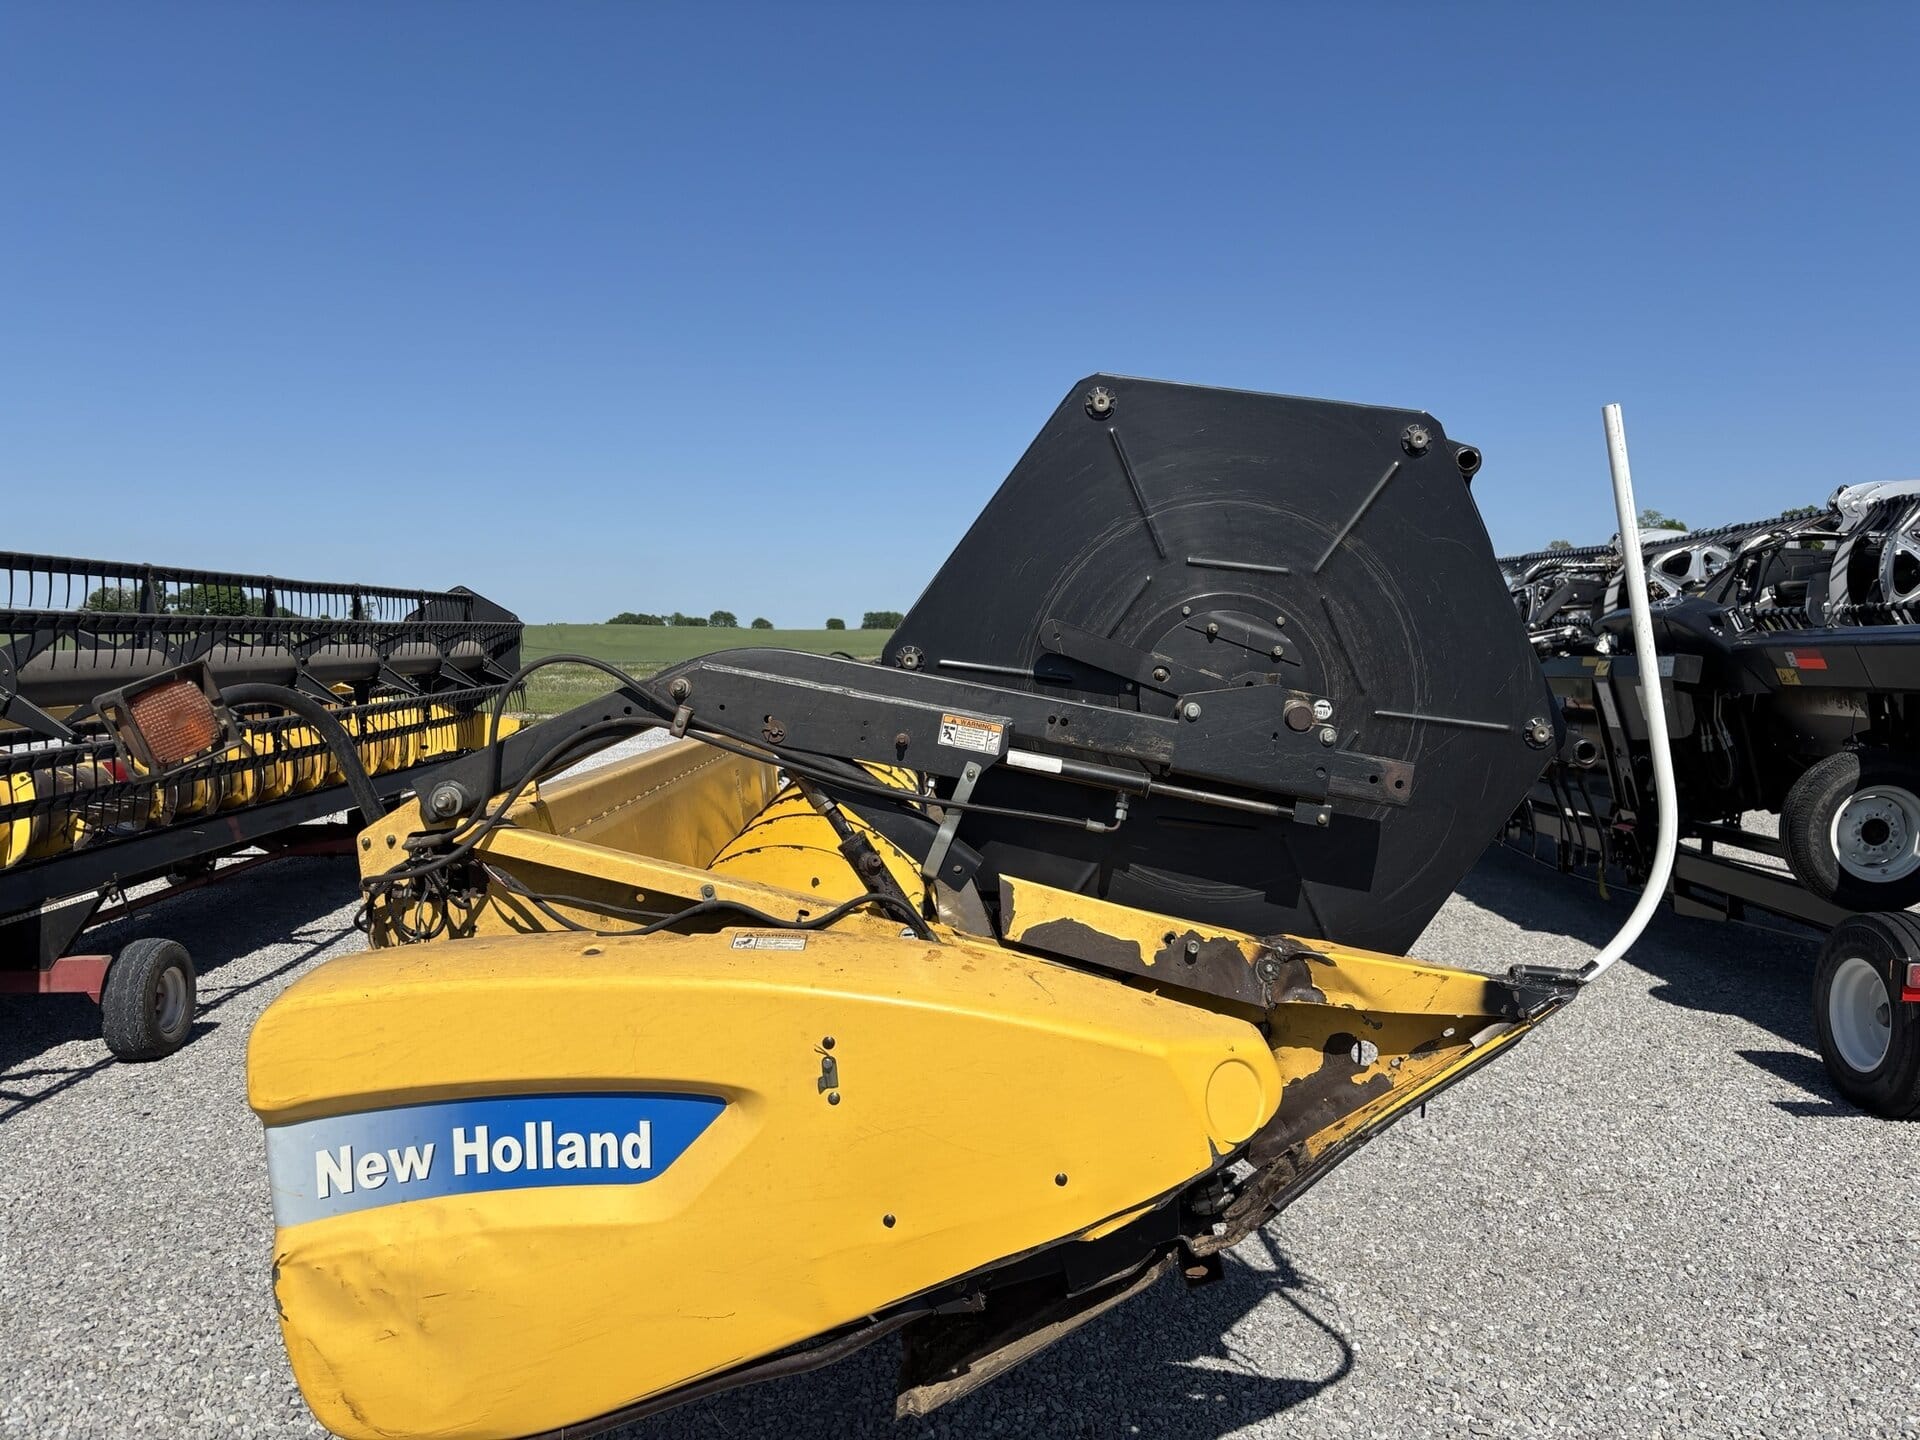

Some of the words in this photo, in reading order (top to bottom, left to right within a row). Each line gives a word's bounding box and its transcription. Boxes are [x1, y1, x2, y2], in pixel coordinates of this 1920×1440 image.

[961, 719, 992, 730] WARNING
[316, 1143, 436, 1200] New
[452, 1120, 652, 1176] Holland
